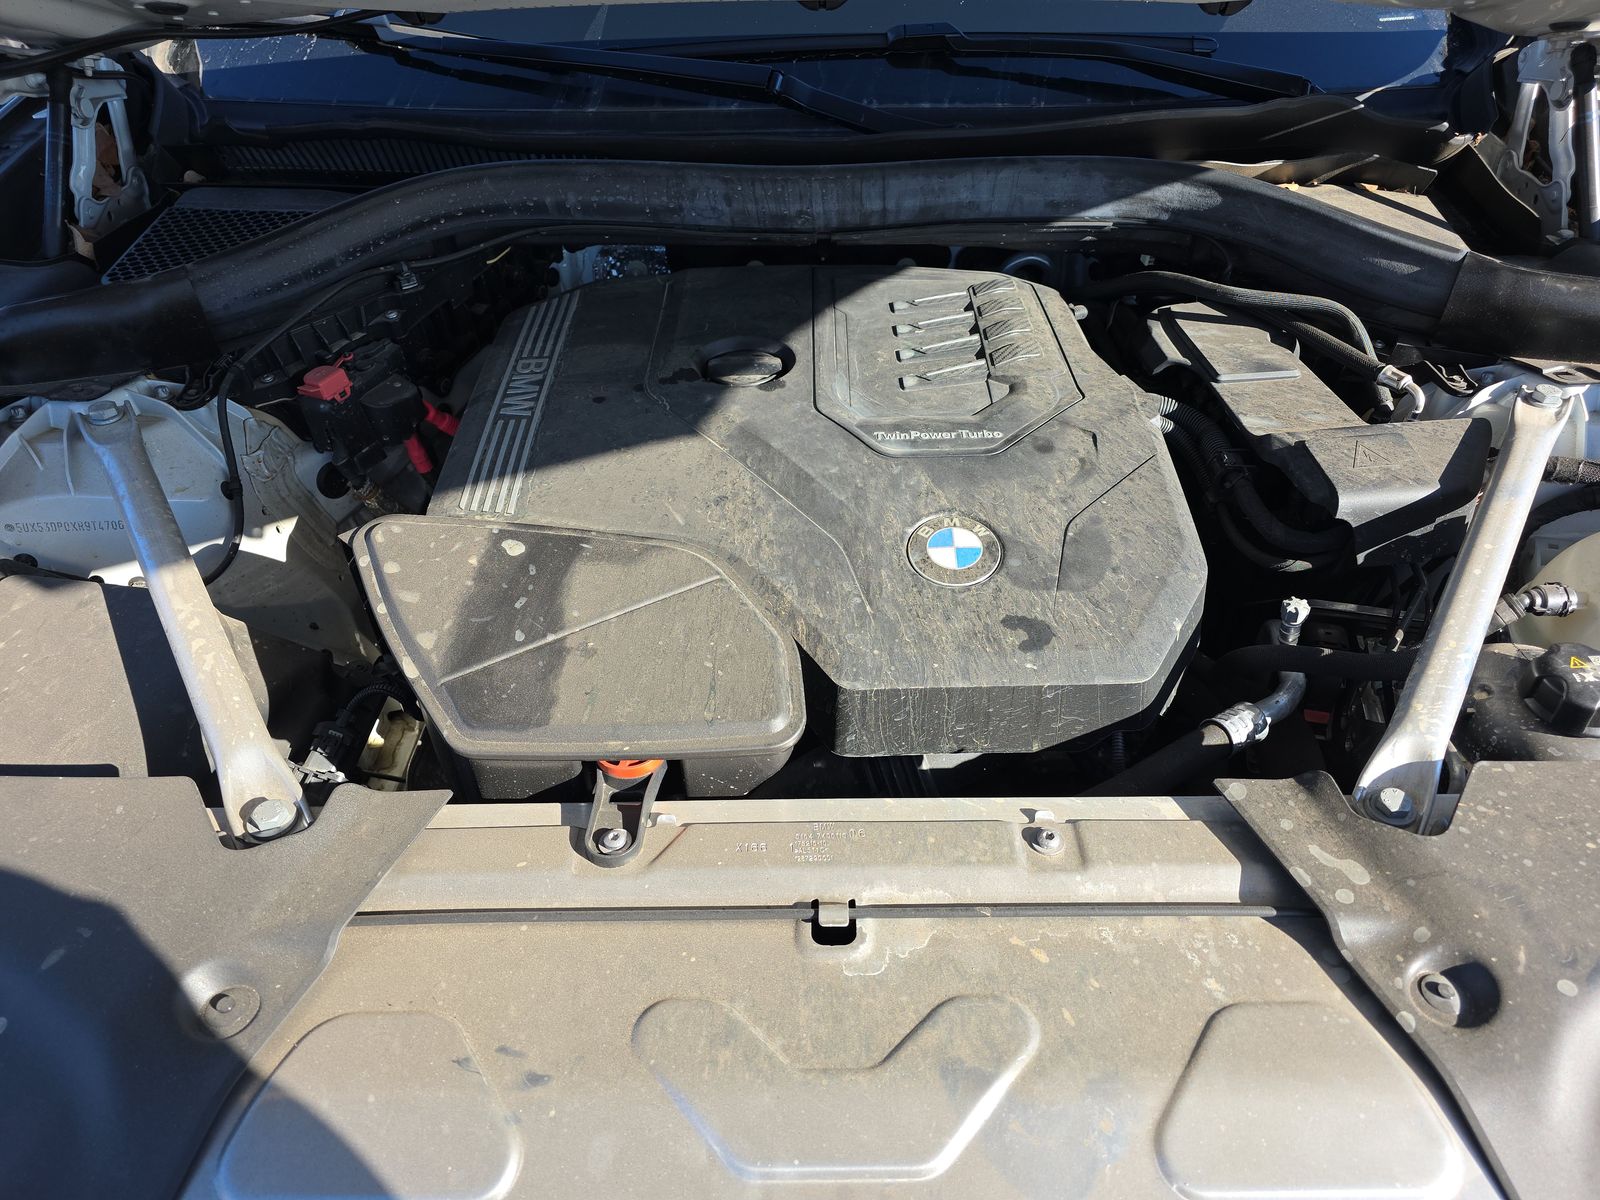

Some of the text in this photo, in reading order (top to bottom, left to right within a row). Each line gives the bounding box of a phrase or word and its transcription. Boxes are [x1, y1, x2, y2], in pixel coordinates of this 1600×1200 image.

[500, 356, 549, 416] BMW
[874, 429, 1003, 441] TwinPower Turbo
[918, 516, 990, 538] BMW
